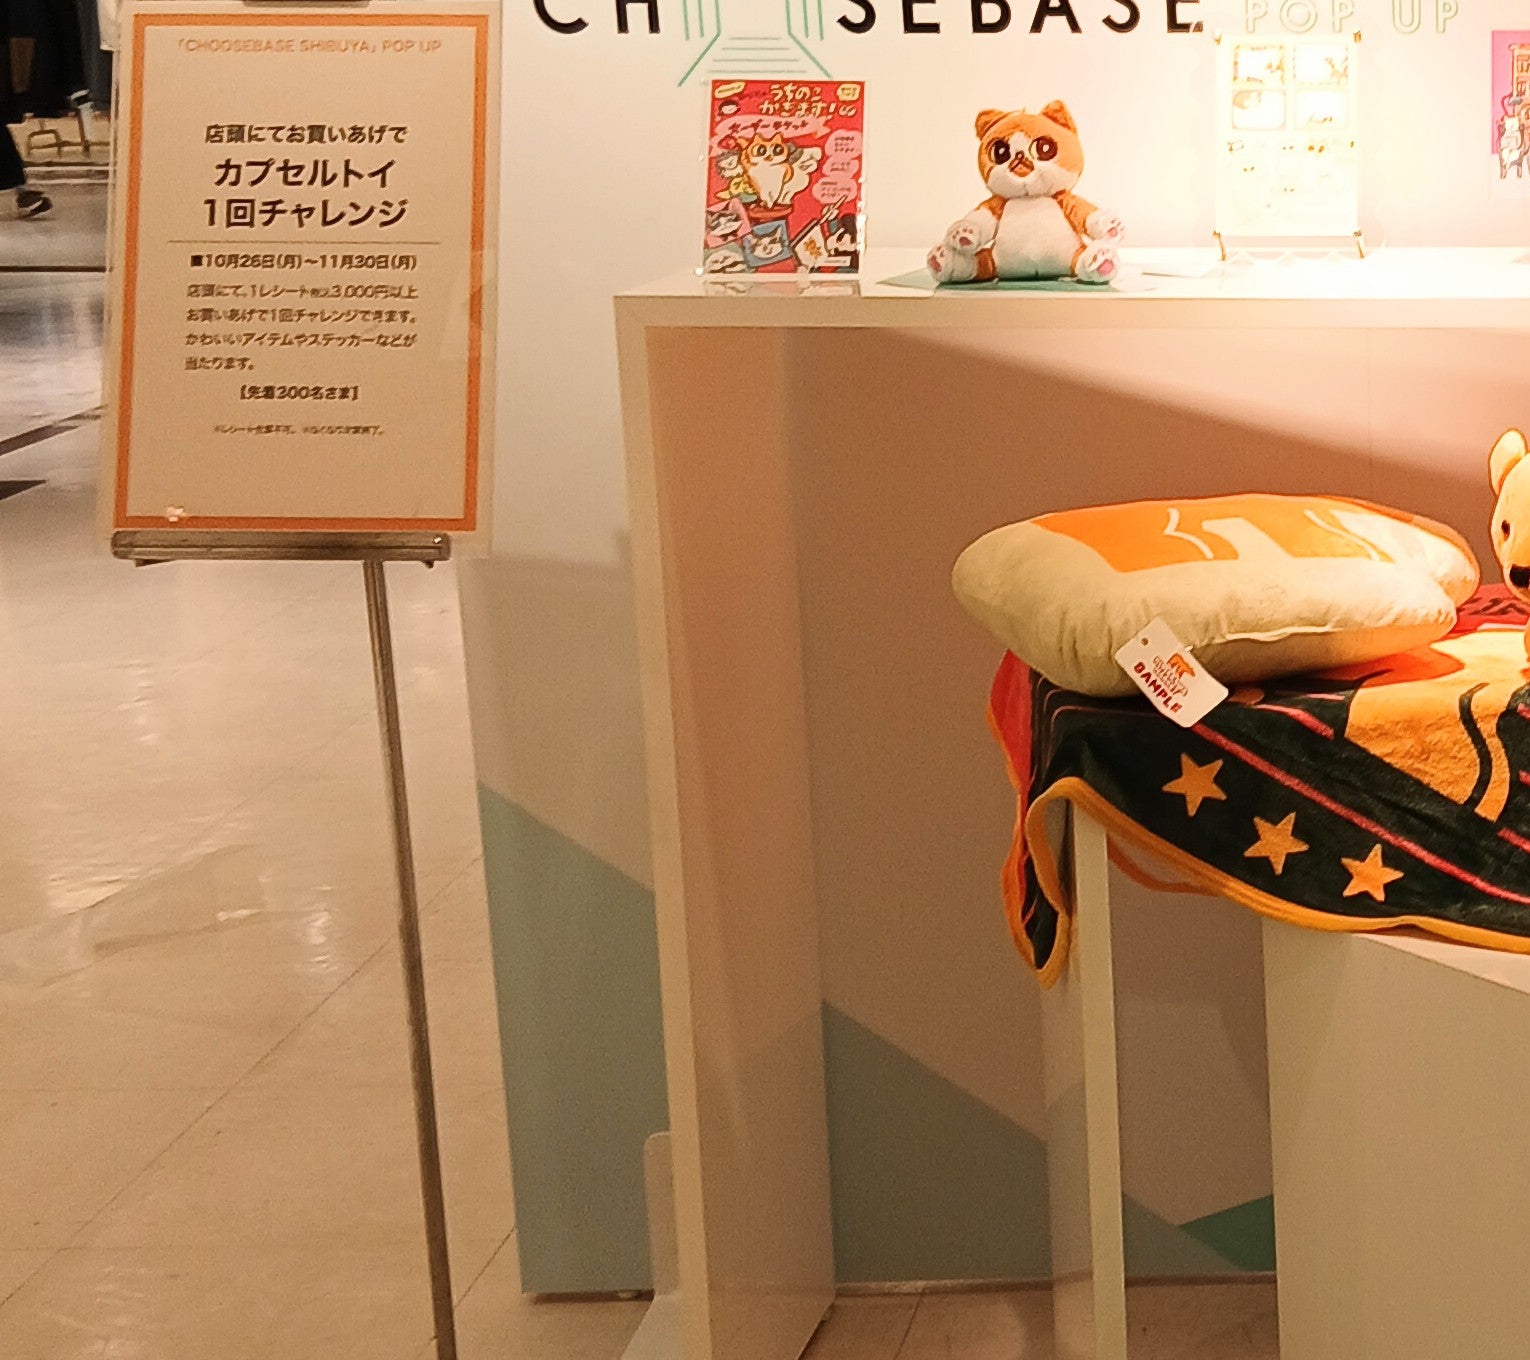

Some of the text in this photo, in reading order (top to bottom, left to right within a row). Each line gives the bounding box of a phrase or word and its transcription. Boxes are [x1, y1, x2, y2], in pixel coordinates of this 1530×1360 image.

[382, 39, 415, 53] POP
[419, 39, 442, 53] UP
[204, 124, 408, 144] 店頭にてお買いあげで
[214, 158, 397, 189] カプセルトイ
[202, 198, 409, 229] 1回チャレンジ
[185, 356, 254, 371] 当たります。
